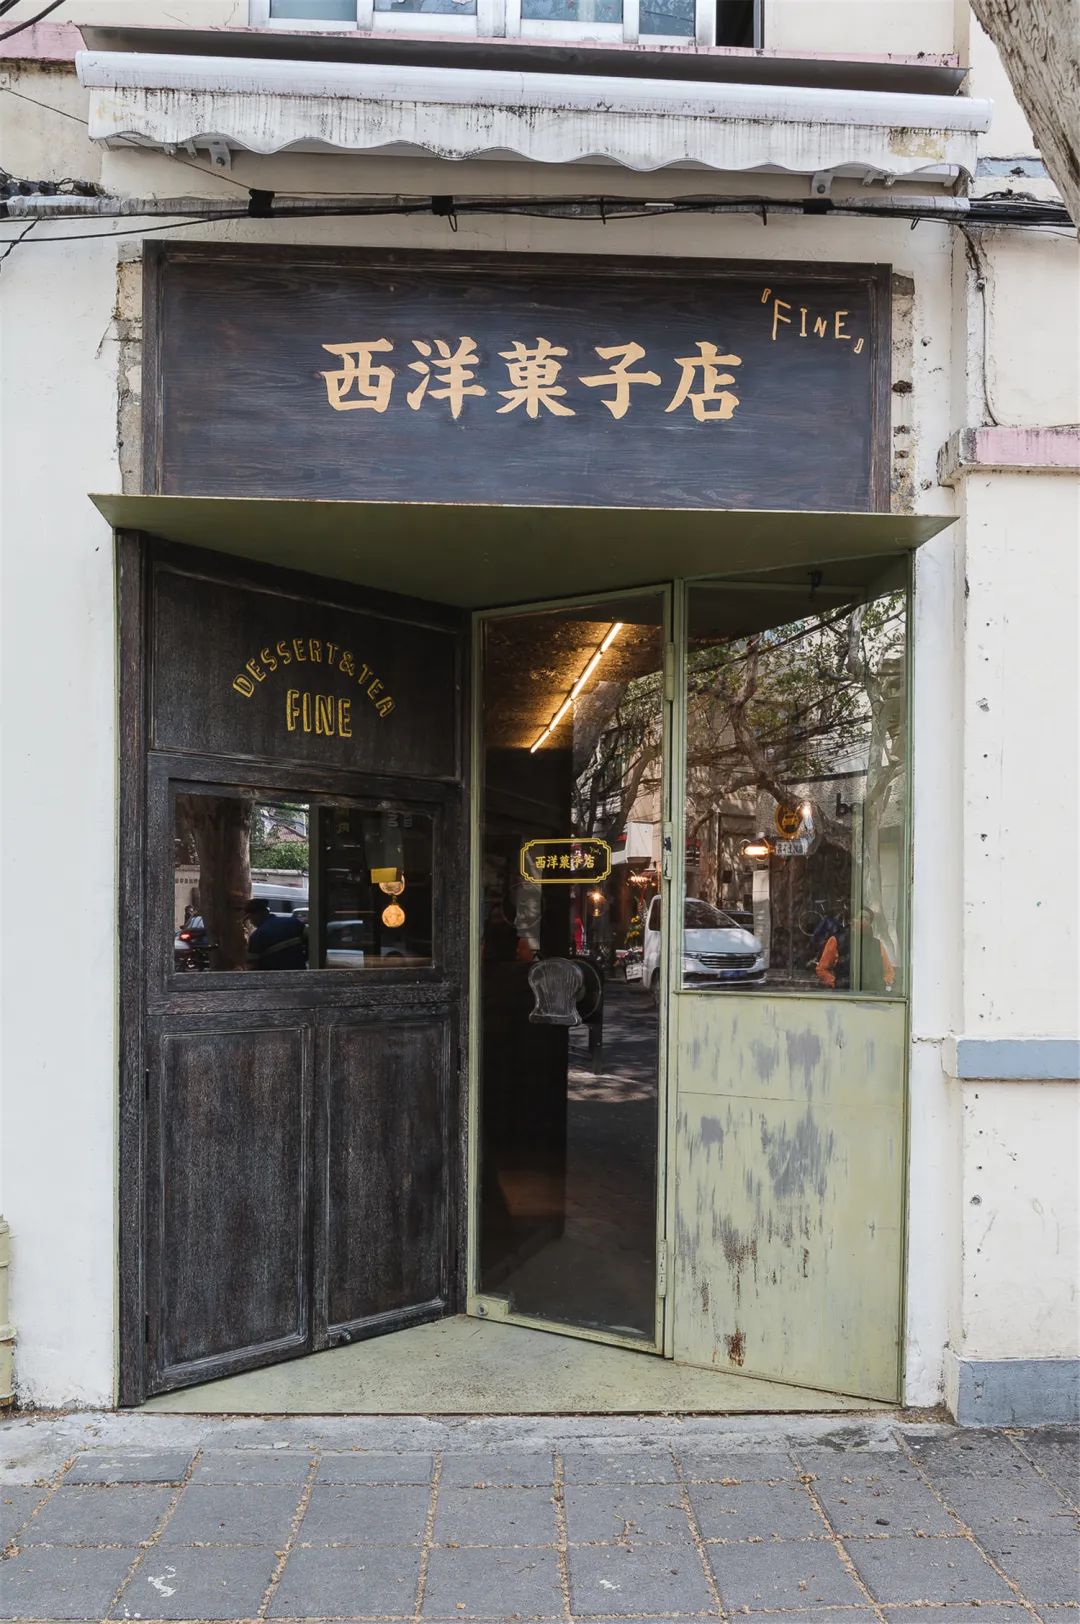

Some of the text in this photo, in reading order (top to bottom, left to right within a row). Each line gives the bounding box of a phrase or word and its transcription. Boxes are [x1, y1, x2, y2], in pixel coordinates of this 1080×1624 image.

[320, 336, 742, 423] 西洋菓子店
[286, 689, 352, 738] FINE
[535, 854, 595, 869] 西洋菓子店
